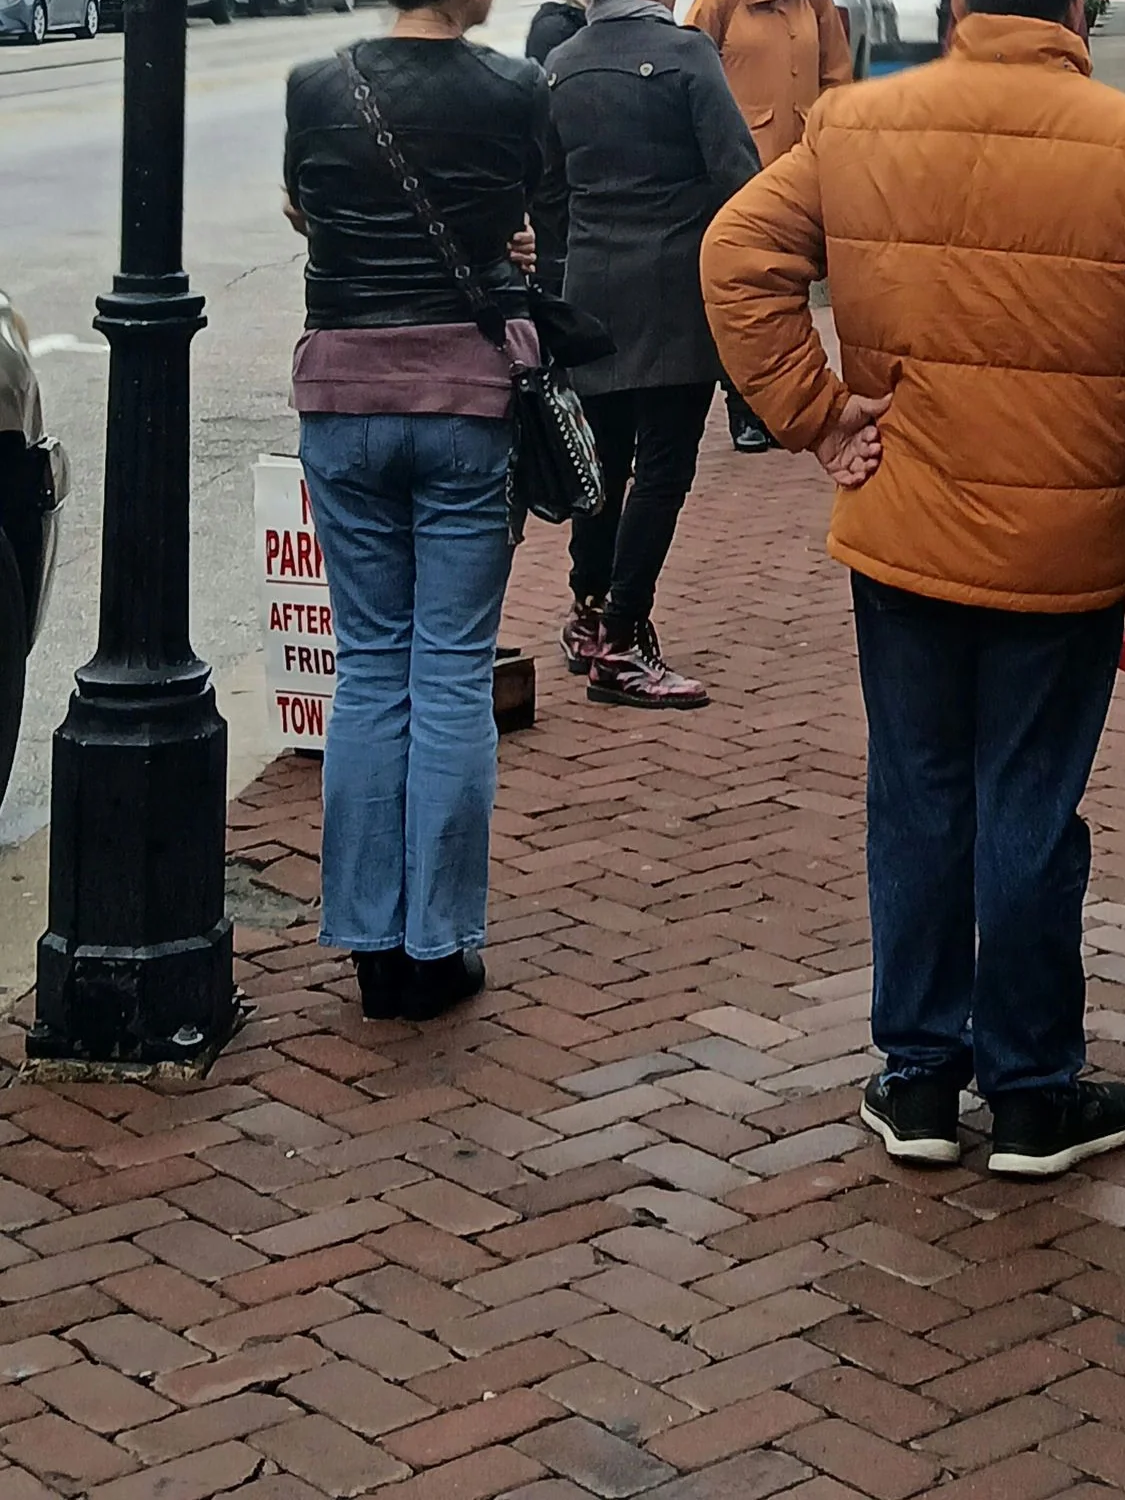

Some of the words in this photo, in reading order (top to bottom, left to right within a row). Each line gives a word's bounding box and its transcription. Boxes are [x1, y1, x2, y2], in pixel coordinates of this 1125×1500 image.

[270, 602, 331, 636] AFTER
[283, 645, 335, 676] FRID
[276, 696, 323, 737] TOW
